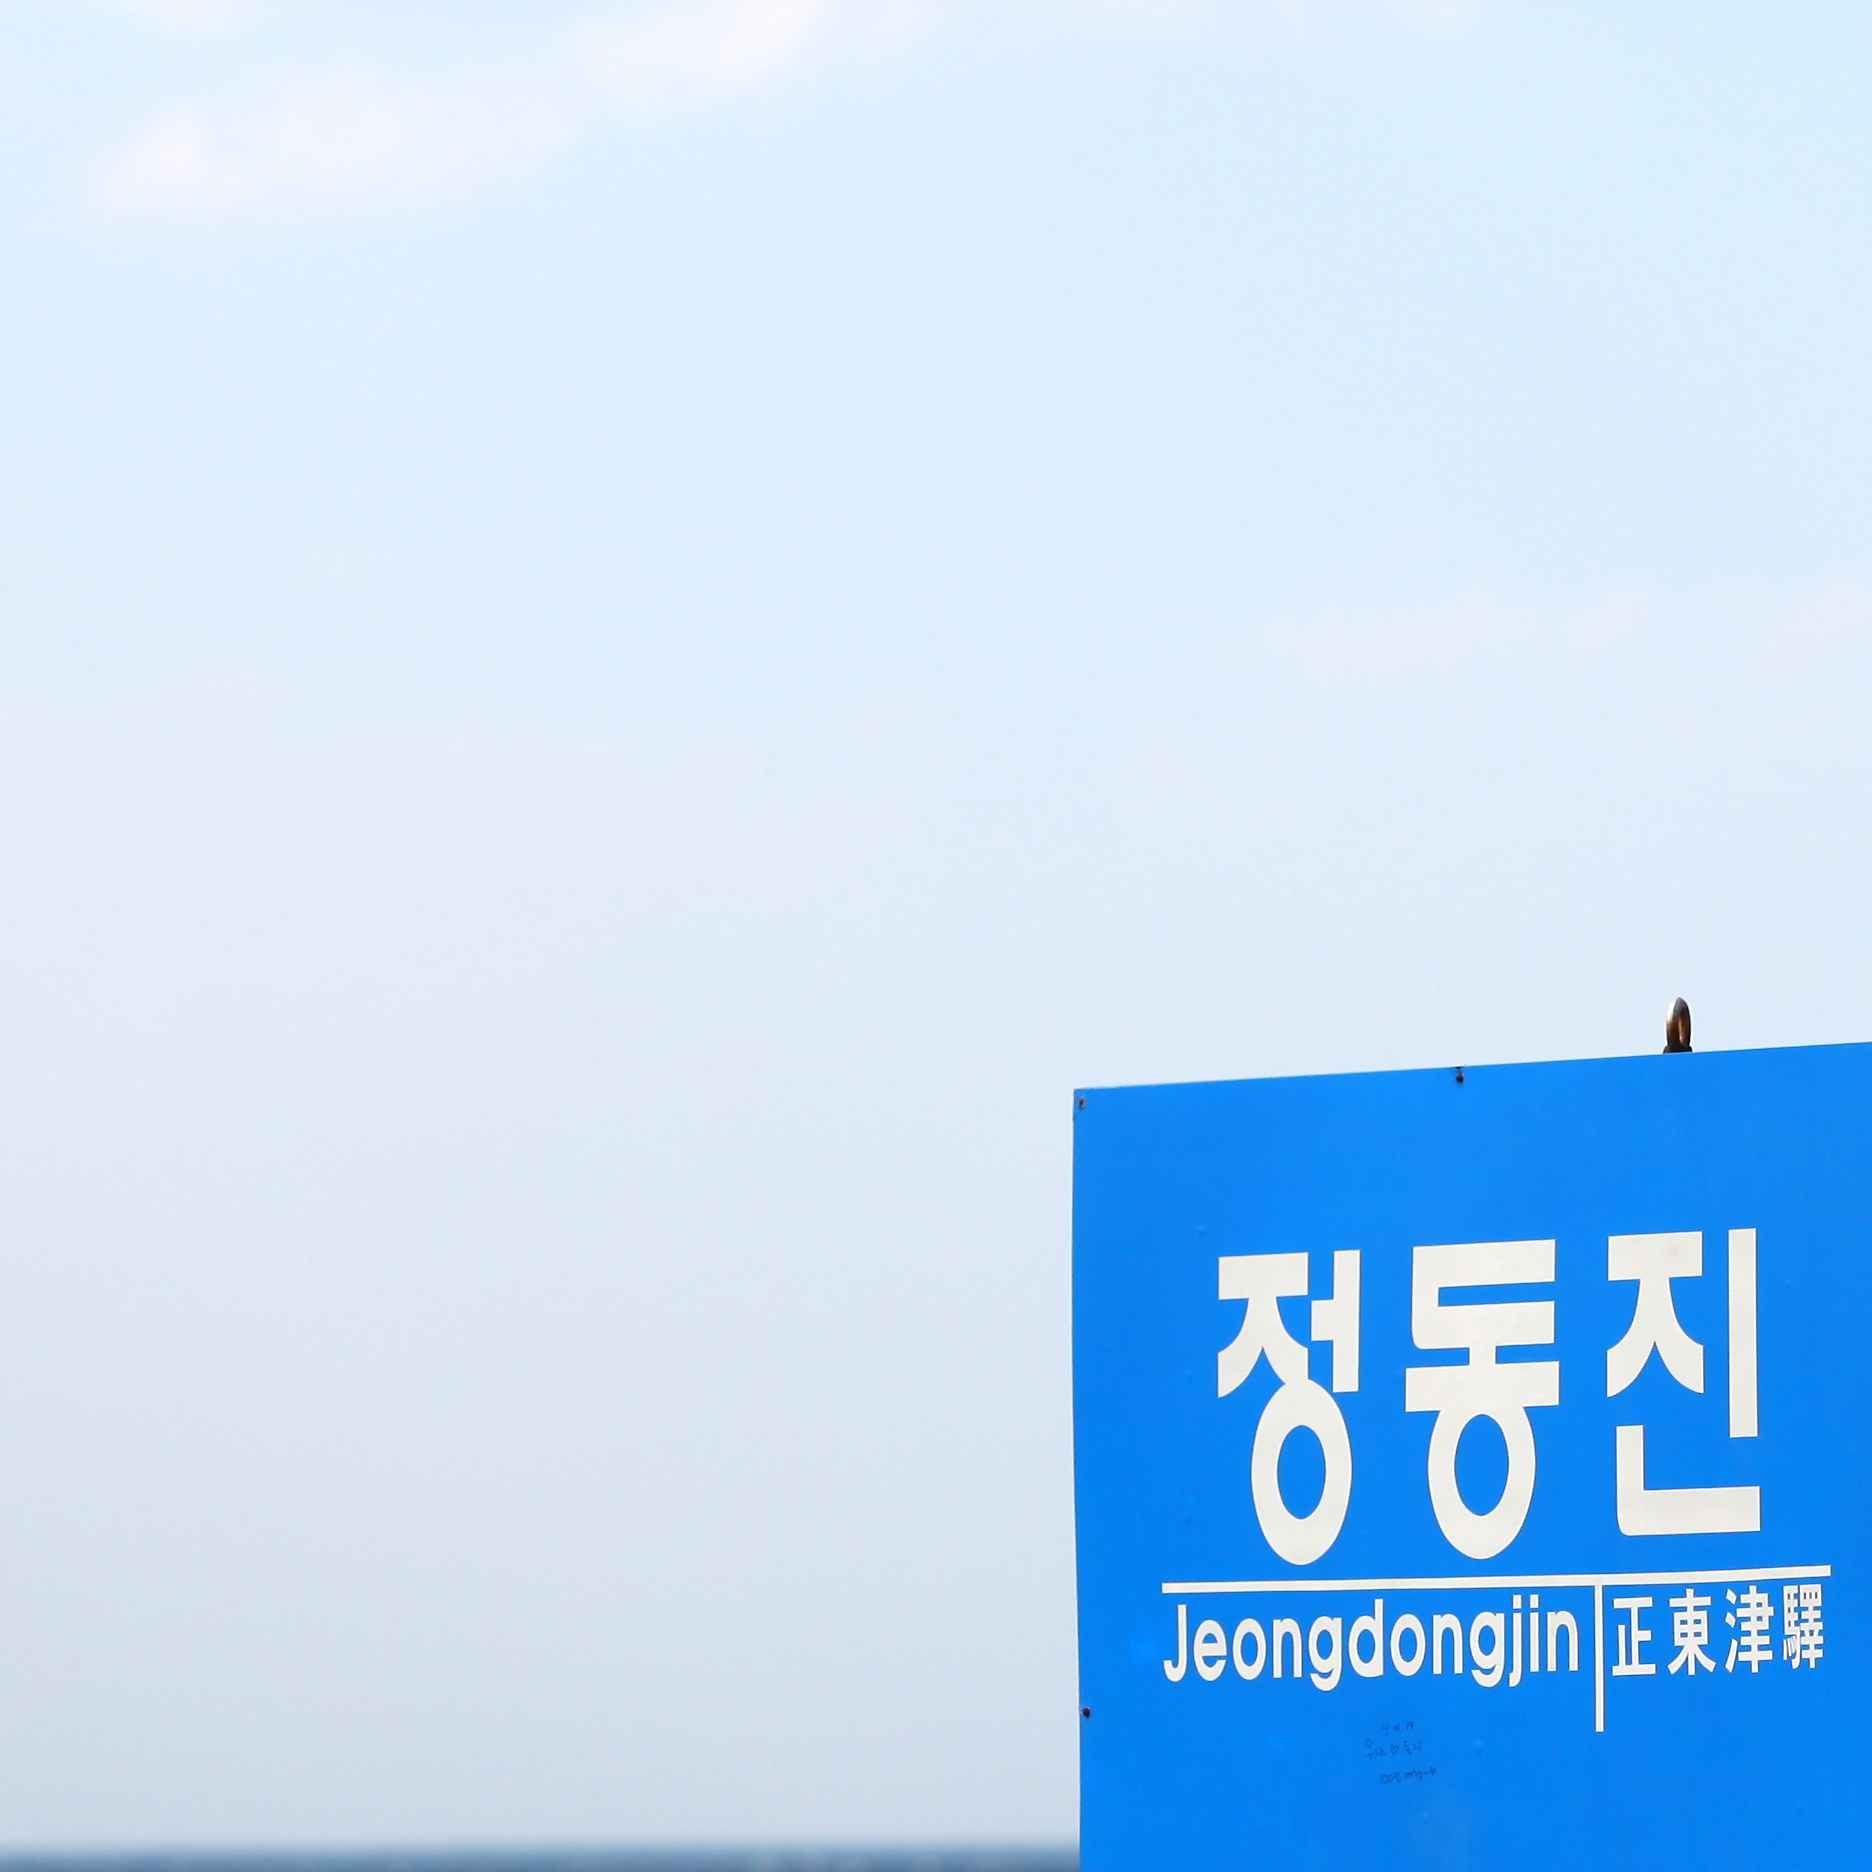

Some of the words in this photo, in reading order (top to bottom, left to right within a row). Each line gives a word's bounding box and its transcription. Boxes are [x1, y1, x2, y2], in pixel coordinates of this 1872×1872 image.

[1218, 1228, 1761, 1565] 정동진
[1163, 1594, 1579, 1692] Jeongdongjin
[1611, 1583, 1824, 1676] 正東津驛
